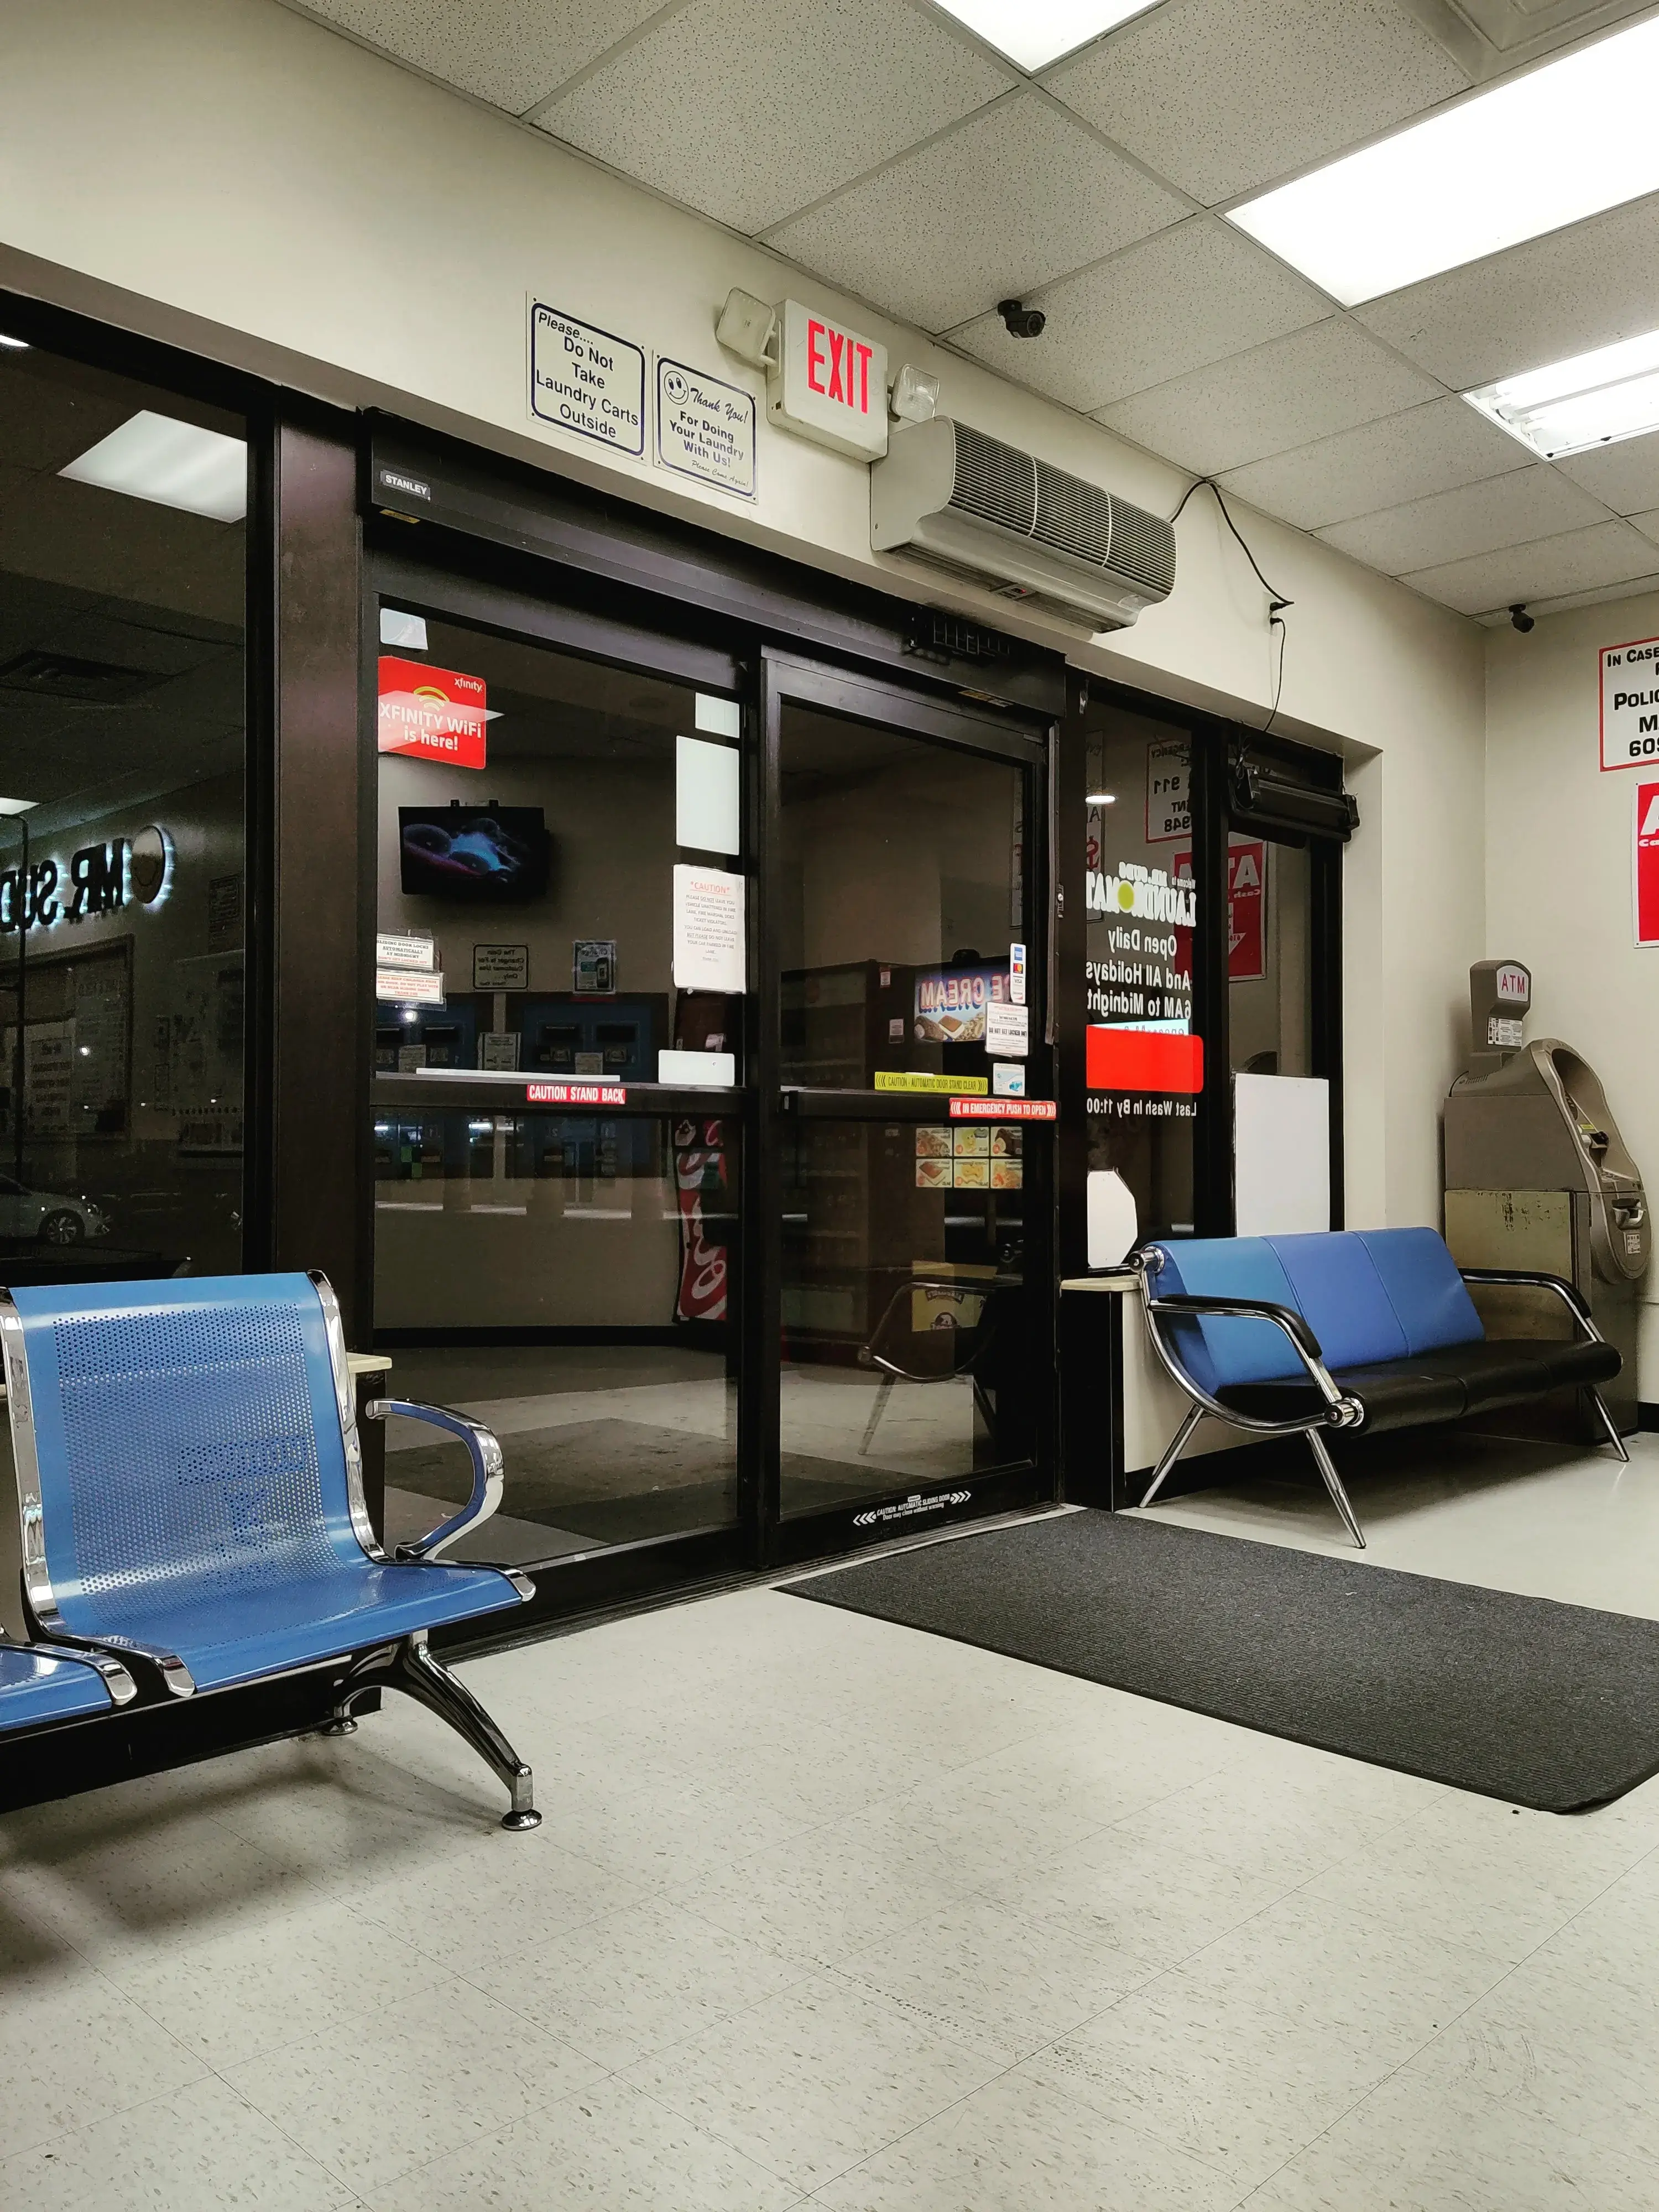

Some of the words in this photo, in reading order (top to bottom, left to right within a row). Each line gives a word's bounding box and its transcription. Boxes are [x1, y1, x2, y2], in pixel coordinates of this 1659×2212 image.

[564, 336, 584, 357] Do
[589, 347, 613, 371] Not
[808, 318, 873, 414] EXIT
[571, 362, 606, 389] Take
[536, 369, 597, 410] Laundry
[601, 398, 639, 426] Carts
[690, 387, 721, 413] Thank
[724, 403, 748, 424] You!
[560, 403, 616, 438] Outside
[680, 410, 698, 427] For
[702, 420, 734, 444] Doing
[669, 419, 695, 440] Your
[699, 432, 744, 461] Laundry
[684, 440, 709, 460] With
[713, 452, 731, 468] Us!
[385, 474, 427, 495] STANLEY
[691, 460, 710, 472] Please
[712, 469, 727, 479] Come
[729, 476, 749, 487] Again!
[1606, 654, 1621, 667] IN
[454, 677, 483, 693] xfinity
[379, 702, 444, 729] XFINITY
[446, 717, 482, 738] WiFi
[1639, 714, 1659, 733] M
[404, 725, 417, 742] is
[421, 729, 458, 751] here!
[1629, 737, 1659, 757] 60
[382, 946, 423, 954] AUTOMATICALLY
[1501, 973, 1525, 994] ATM
[529, 1084, 567, 1101] CAUTION
[570, 1086, 598, 1102] STAND
[602, 1088, 624, 1103] BACK
[888, 1077, 907, 1087] CAUTION
[911, 1077, 936, 1088] AUTOMATIC
[936, 1079, 948, 1089] DOOR
[949, 1079, 962, 1089] STAND
[963, 1081, 977, 1090] CLEAR
[962, 1103, 969, 1114] IN
[970, 1102, 1005, 1114] EMERGENCY
[1006, 1104, 1021, 1114] PUSH
[1022, 1104, 1030, 1115] TO
[1031, 1105, 1046, 1115] OPEN
[898, 1500, 922, 1511] AUTOMATIC
[922, 1496, 938, 1505] SLIDING
[938, 1493, 950, 1502] DOOR
